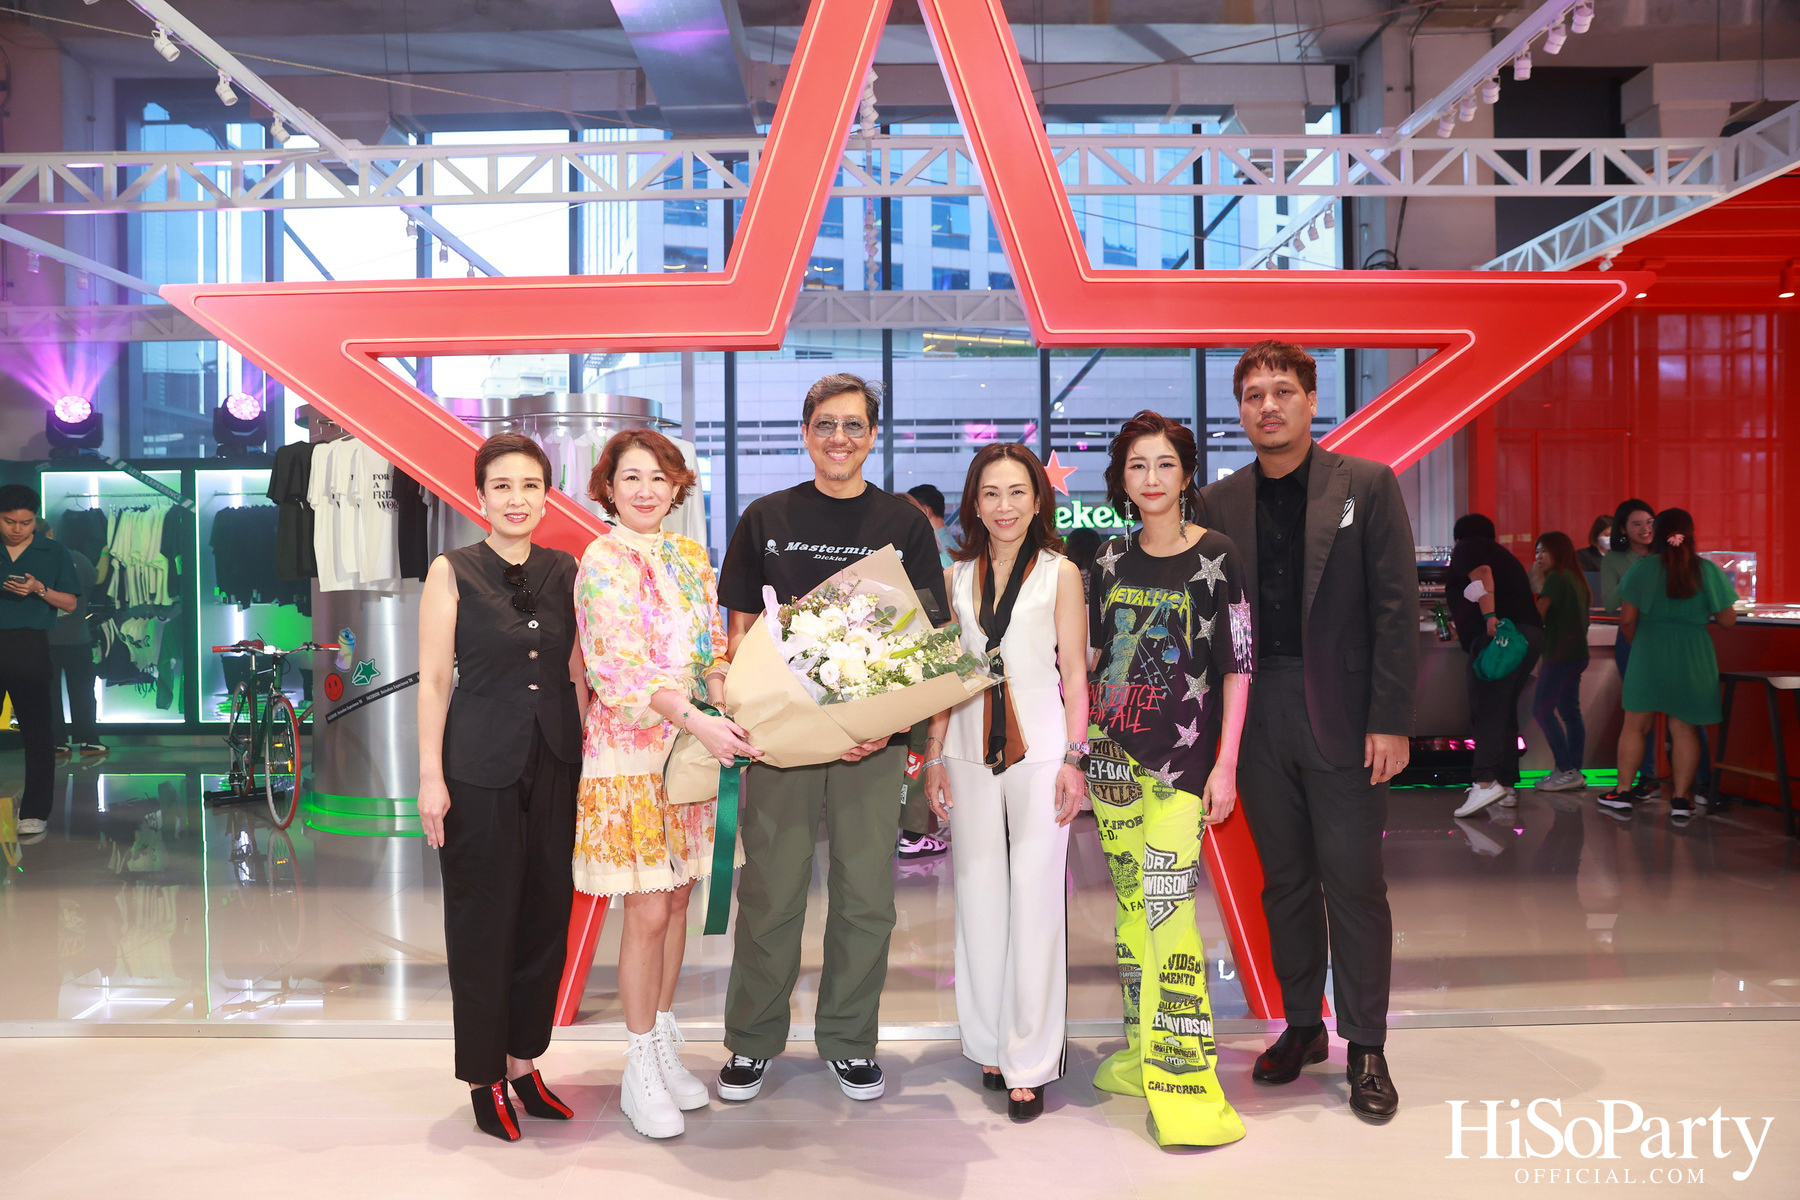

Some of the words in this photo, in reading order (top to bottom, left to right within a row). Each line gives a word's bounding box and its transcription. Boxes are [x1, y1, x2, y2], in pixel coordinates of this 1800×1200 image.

[372, 473, 390, 481] FOR
[373, 481, 380, 489] A
[372, 490, 393, 500] FRE
[376, 500, 400, 510] WOR
[812, 553, 848, 563] Dickies
[1108, 704, 1152, 734] ALL
[1147, 1080, 1208, 1095] CALIFORNIA
